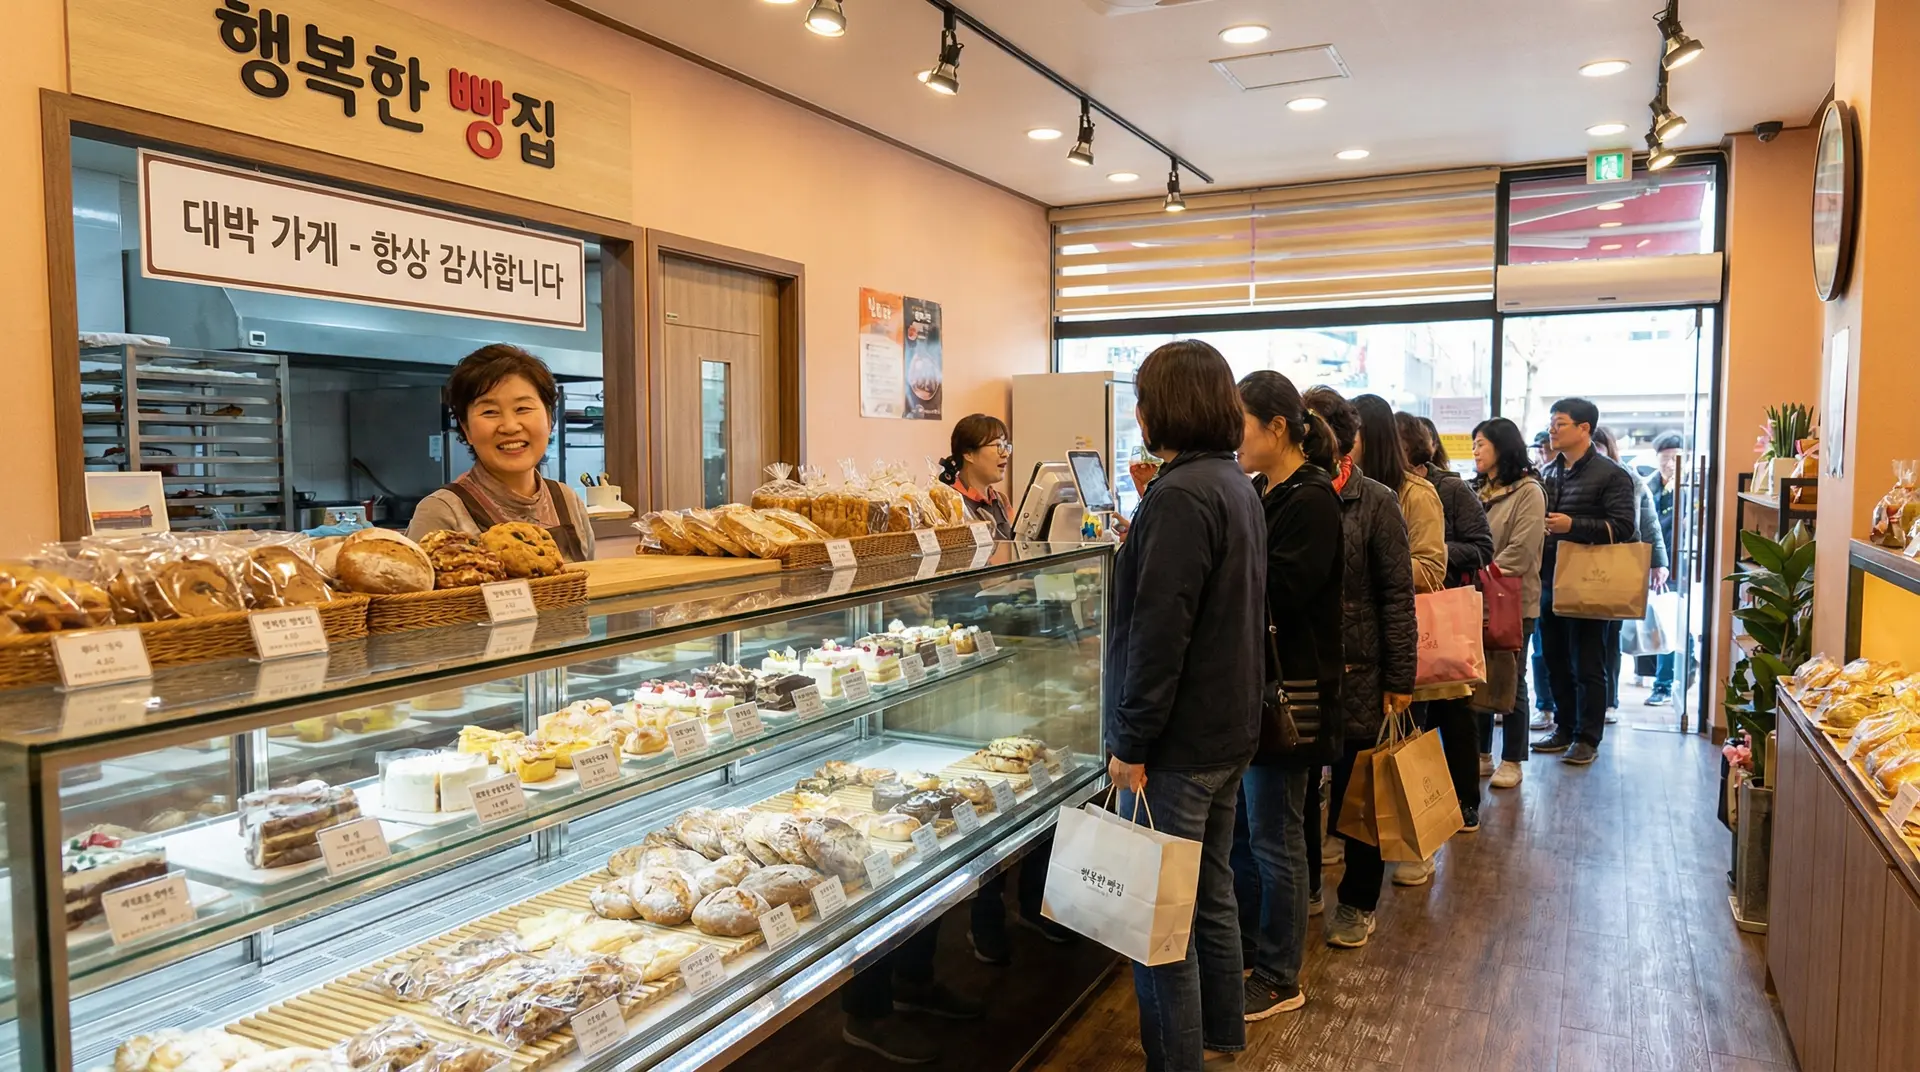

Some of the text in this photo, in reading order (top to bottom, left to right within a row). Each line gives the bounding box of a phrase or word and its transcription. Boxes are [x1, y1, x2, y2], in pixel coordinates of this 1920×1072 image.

[215, 0, 555, 169] 행복한 빵집
[183, 200, 564, 300] 대박 가게 - 항상 감사합니다
[1080, 867, 1106, 889] 행복한
